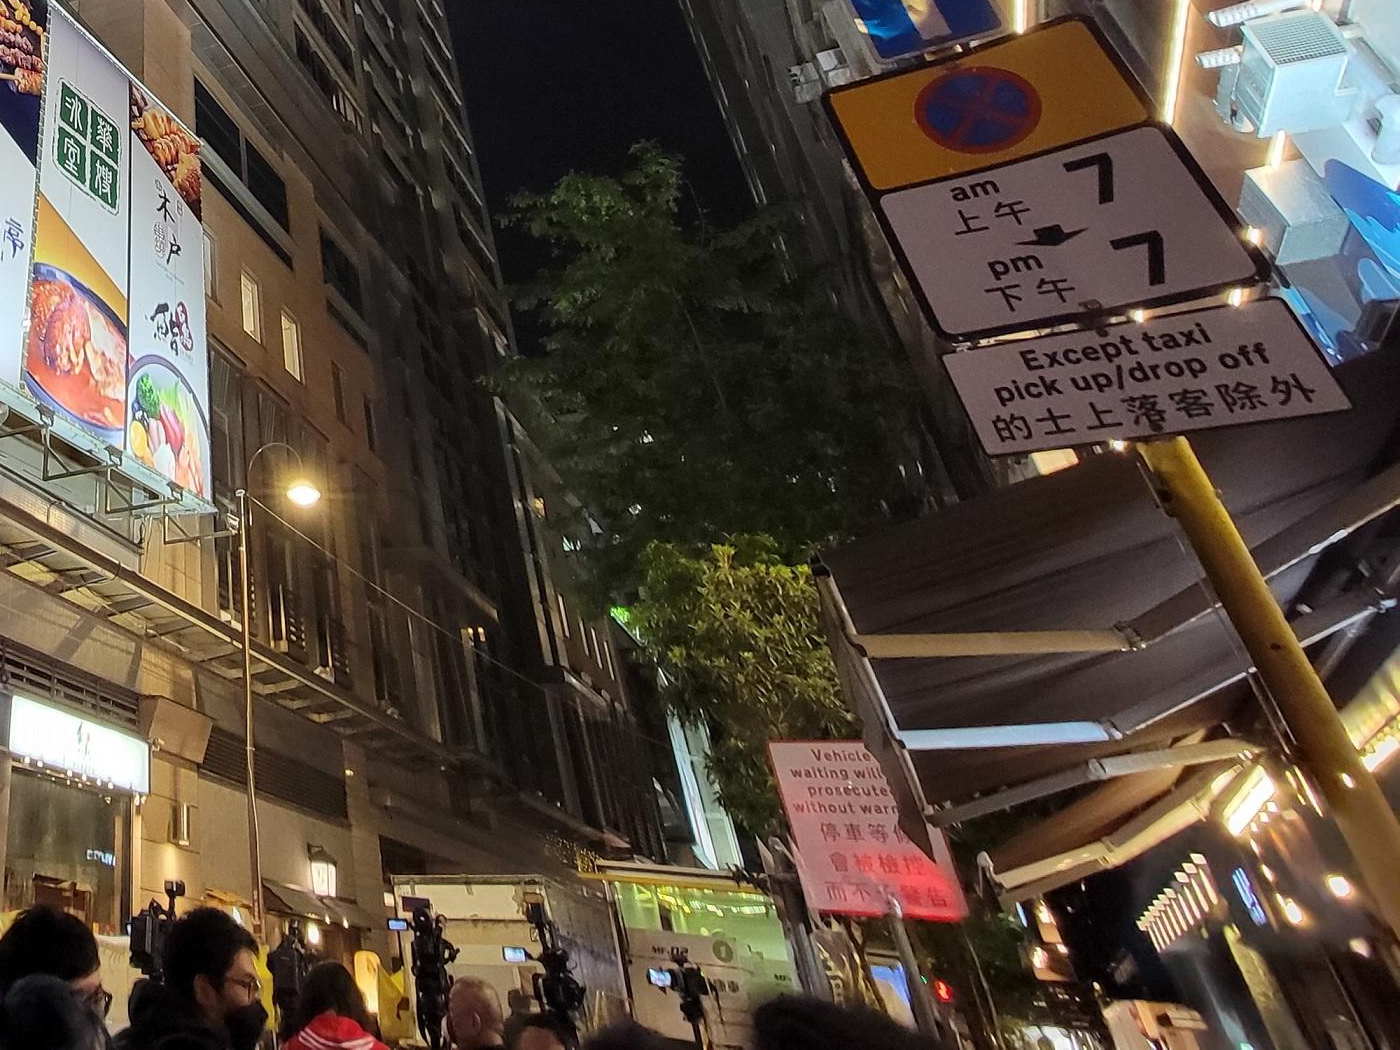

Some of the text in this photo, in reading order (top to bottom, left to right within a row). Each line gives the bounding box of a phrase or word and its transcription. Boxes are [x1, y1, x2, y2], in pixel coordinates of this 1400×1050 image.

[950, 179, 1000, 202] am
[1063, 152, 1115, 204] 7
[954, 200, 1032, 236] 上午
[986, 254, 1044, 281] pm
[1109, 229, 1166, 286] 7
[983, 277, 1076, 312] 下午
[1019, 322, 1212, 371] Except taxi
[993, 341, 1271, 408] pick up/drop off
[991, 373, 1317, 443] 的士上落客除外
[790, 767, 885, 781] waiting will
[808, 783, 893, 798] prosecute
[792, 802, 856, 815] without
